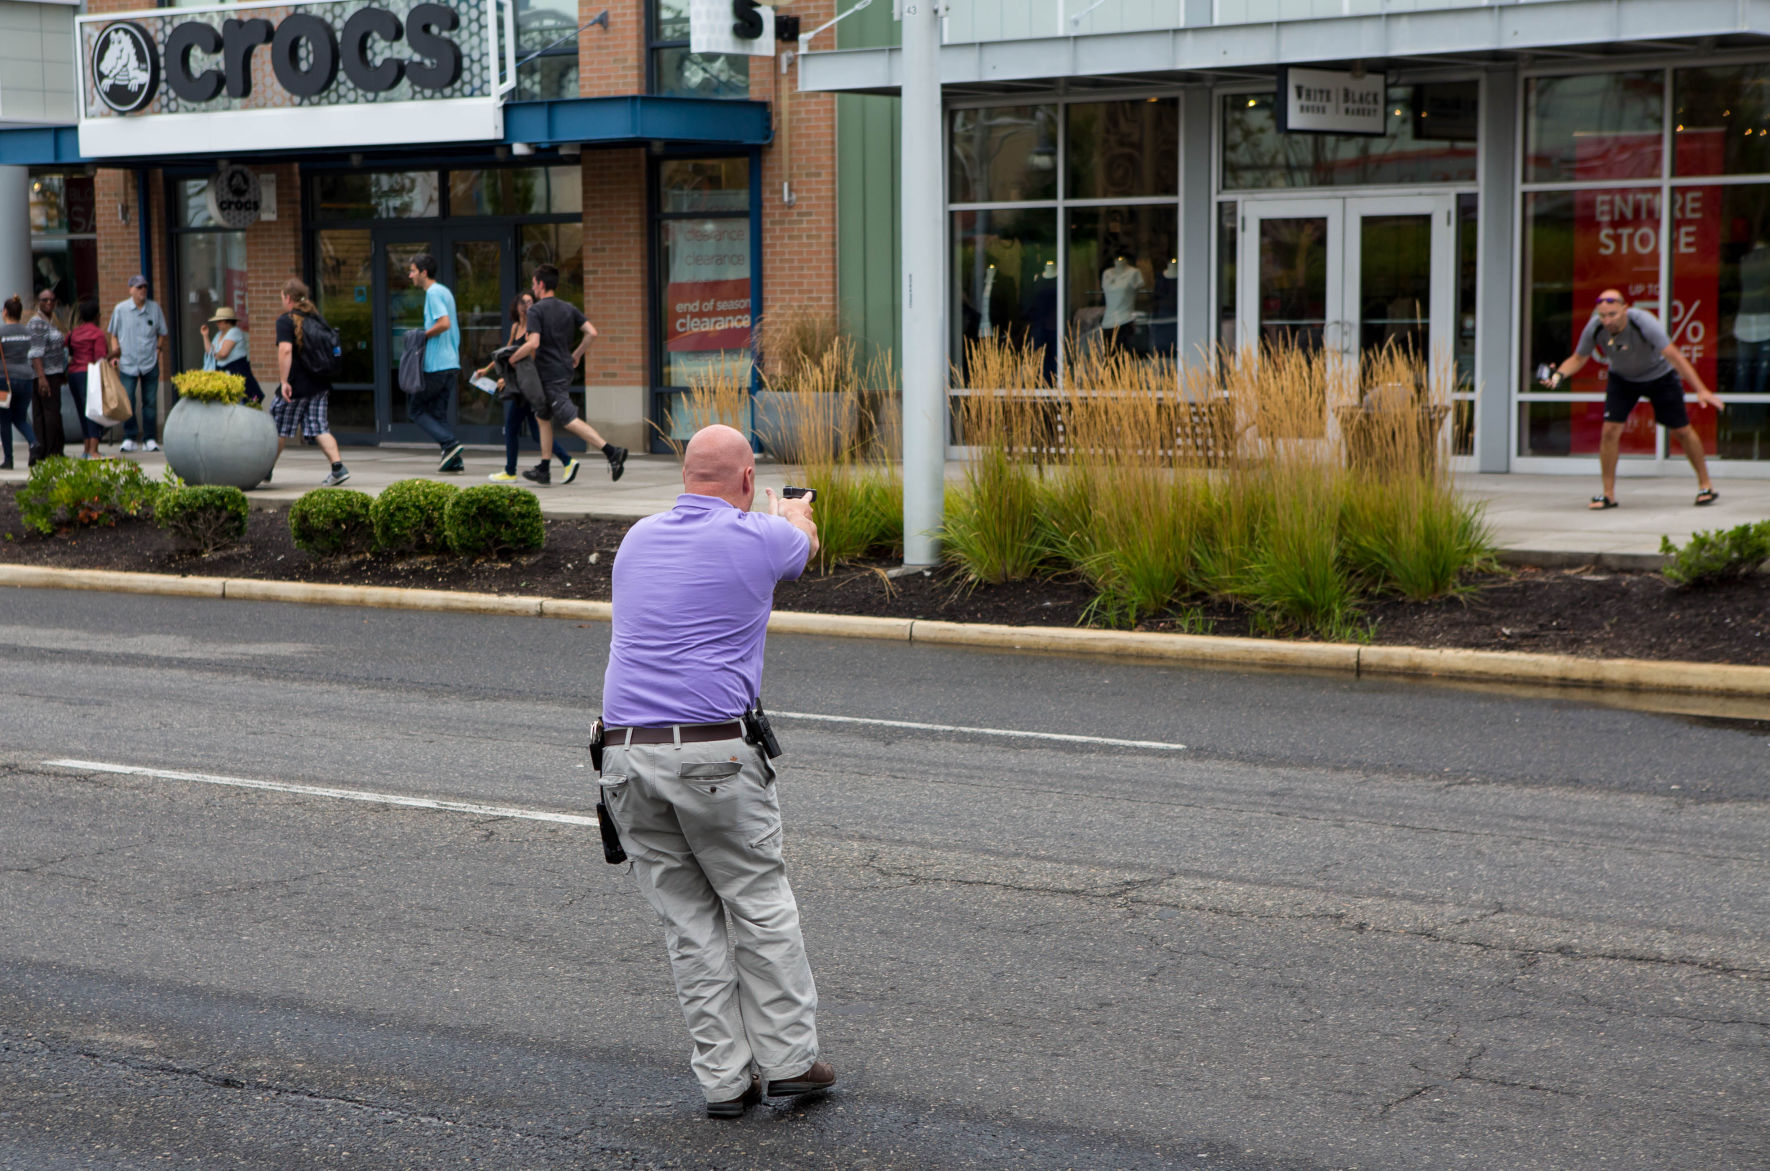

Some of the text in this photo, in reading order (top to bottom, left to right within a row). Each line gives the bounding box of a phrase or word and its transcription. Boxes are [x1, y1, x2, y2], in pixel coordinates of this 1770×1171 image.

[165, 3, 462, 102] crocs
[1295, 85, 1379, 105] WHITE BLACK
[220, 200, 259, 211] crocs
[684, 228, 745, 242] clearance
[685, 251, 745, 266] clearance
[676, 298, 750, 312] end of season
[676, 314, 750, 332] clearance
